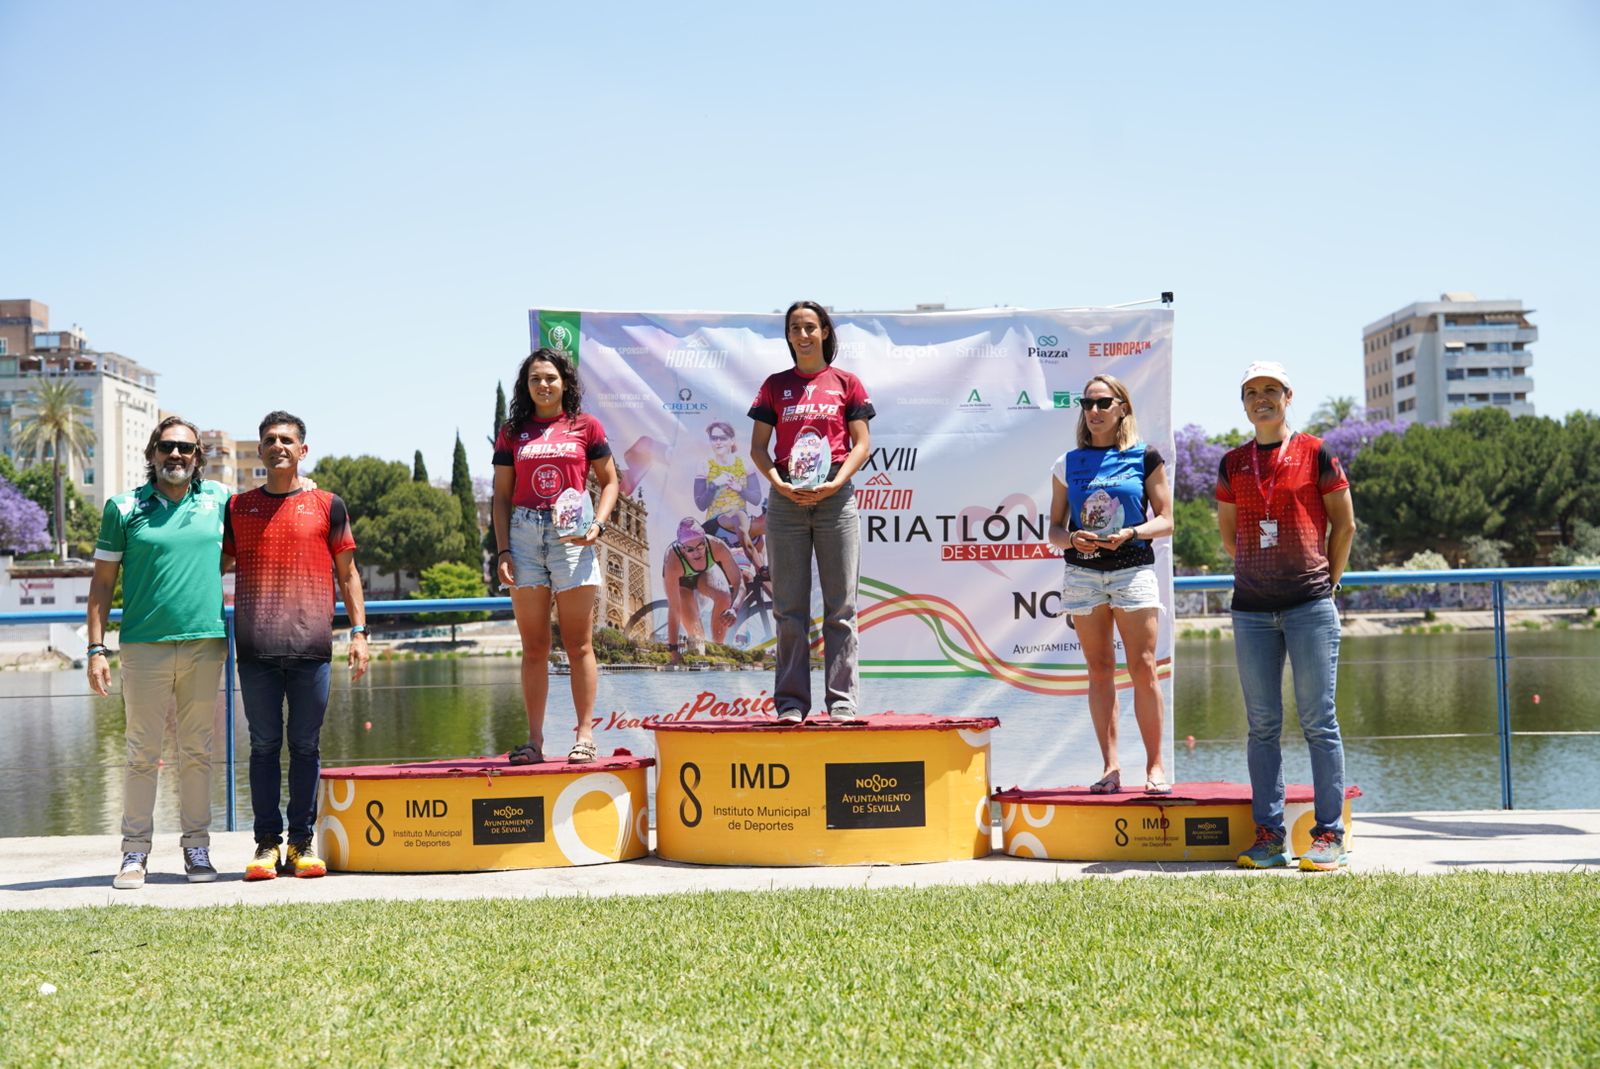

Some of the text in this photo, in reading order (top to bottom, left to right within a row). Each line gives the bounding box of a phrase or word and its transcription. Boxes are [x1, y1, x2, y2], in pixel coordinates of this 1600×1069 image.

[1028, 347, 1069, 358] Piazza
[665, 350, 729, 369] HORIZON
[663, 402, 708, 411] CREDUS
[854, 489, 913, 510] ORIZON
[859, 506, 1044, 543] RIATLÓN
[942, 545, 1044, 560] DE SEVILLA
[1013, 643, 1081, 654] AYUNTAMIENT
[684, 690, 776, 721] Passio
[731, 763, 790, 789] IMD
[842, 793, 911, 804] AYUNTAMIENTO
[406, 799, 449, 818] IMD
[713, 805, 811, 819] Instituto Municipal
[852, 803, 901, 814] DE SEVILLA
[484, 819, 534, 828] AYUNTAMIENTO
[728, 820, 794, 833] de Deportes
[1142, 818, 1170, 829] IMD
[393, 829, 463, 839] Instituto Municipal
[501, 826, 527, 834] SEVILLA
[415, 840, 451, 848] Deportes
